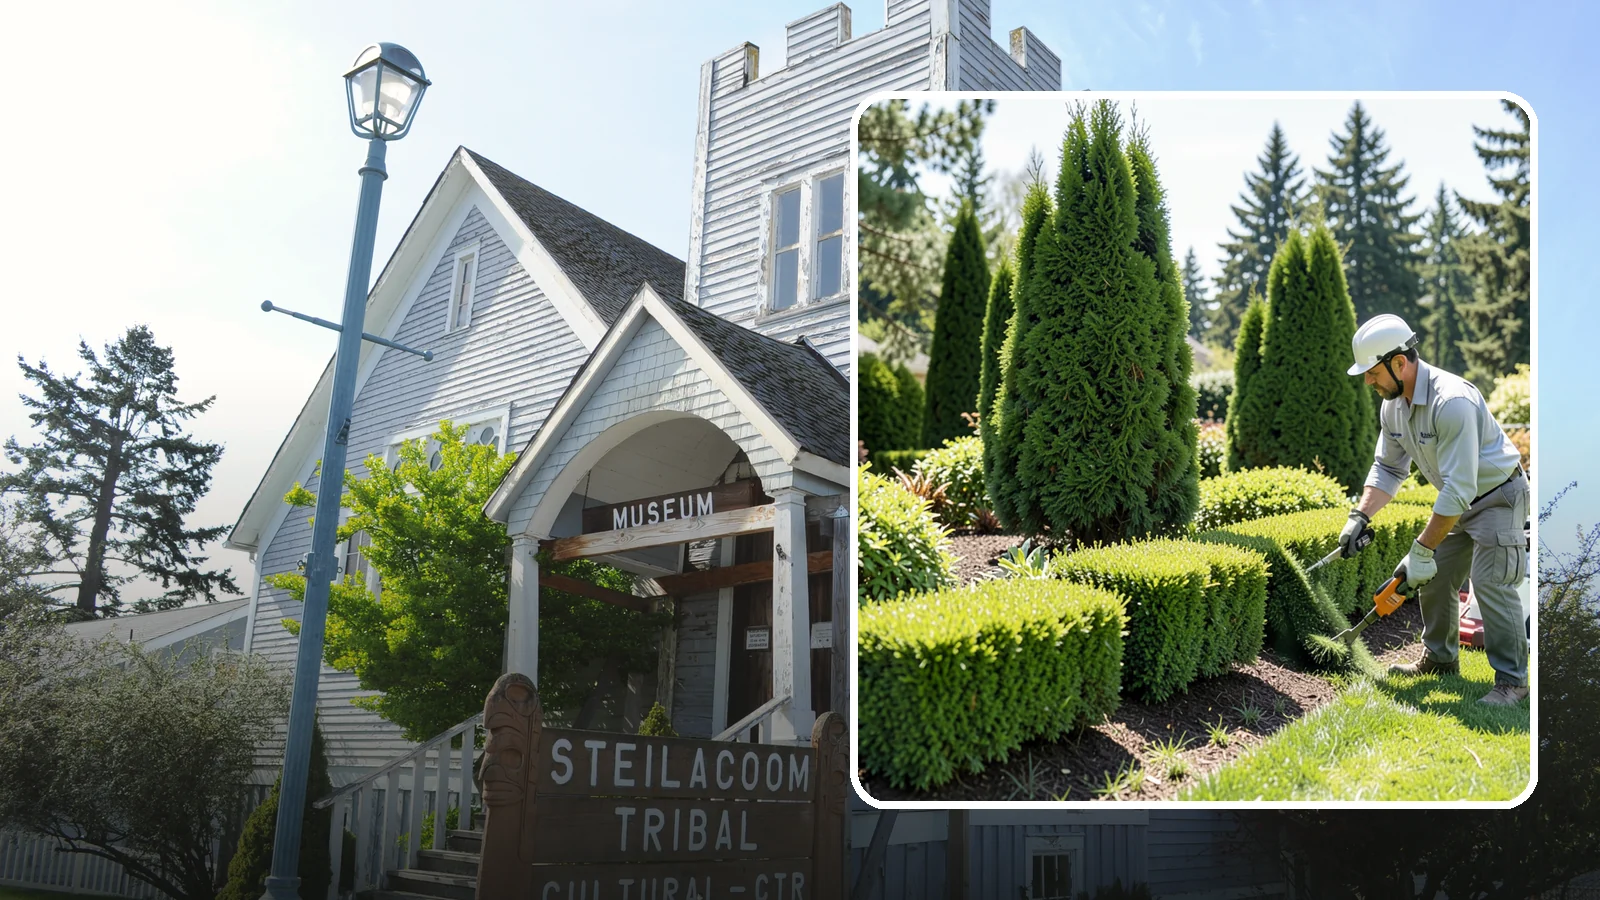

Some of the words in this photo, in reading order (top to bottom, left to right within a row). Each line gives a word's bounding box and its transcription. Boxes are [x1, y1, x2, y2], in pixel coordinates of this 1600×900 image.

[612, 491, 714, 530] MUSEUM
[550, 738, 809, 792] STEILACOOM
[614, 806, 758, 852] TRIBAL
